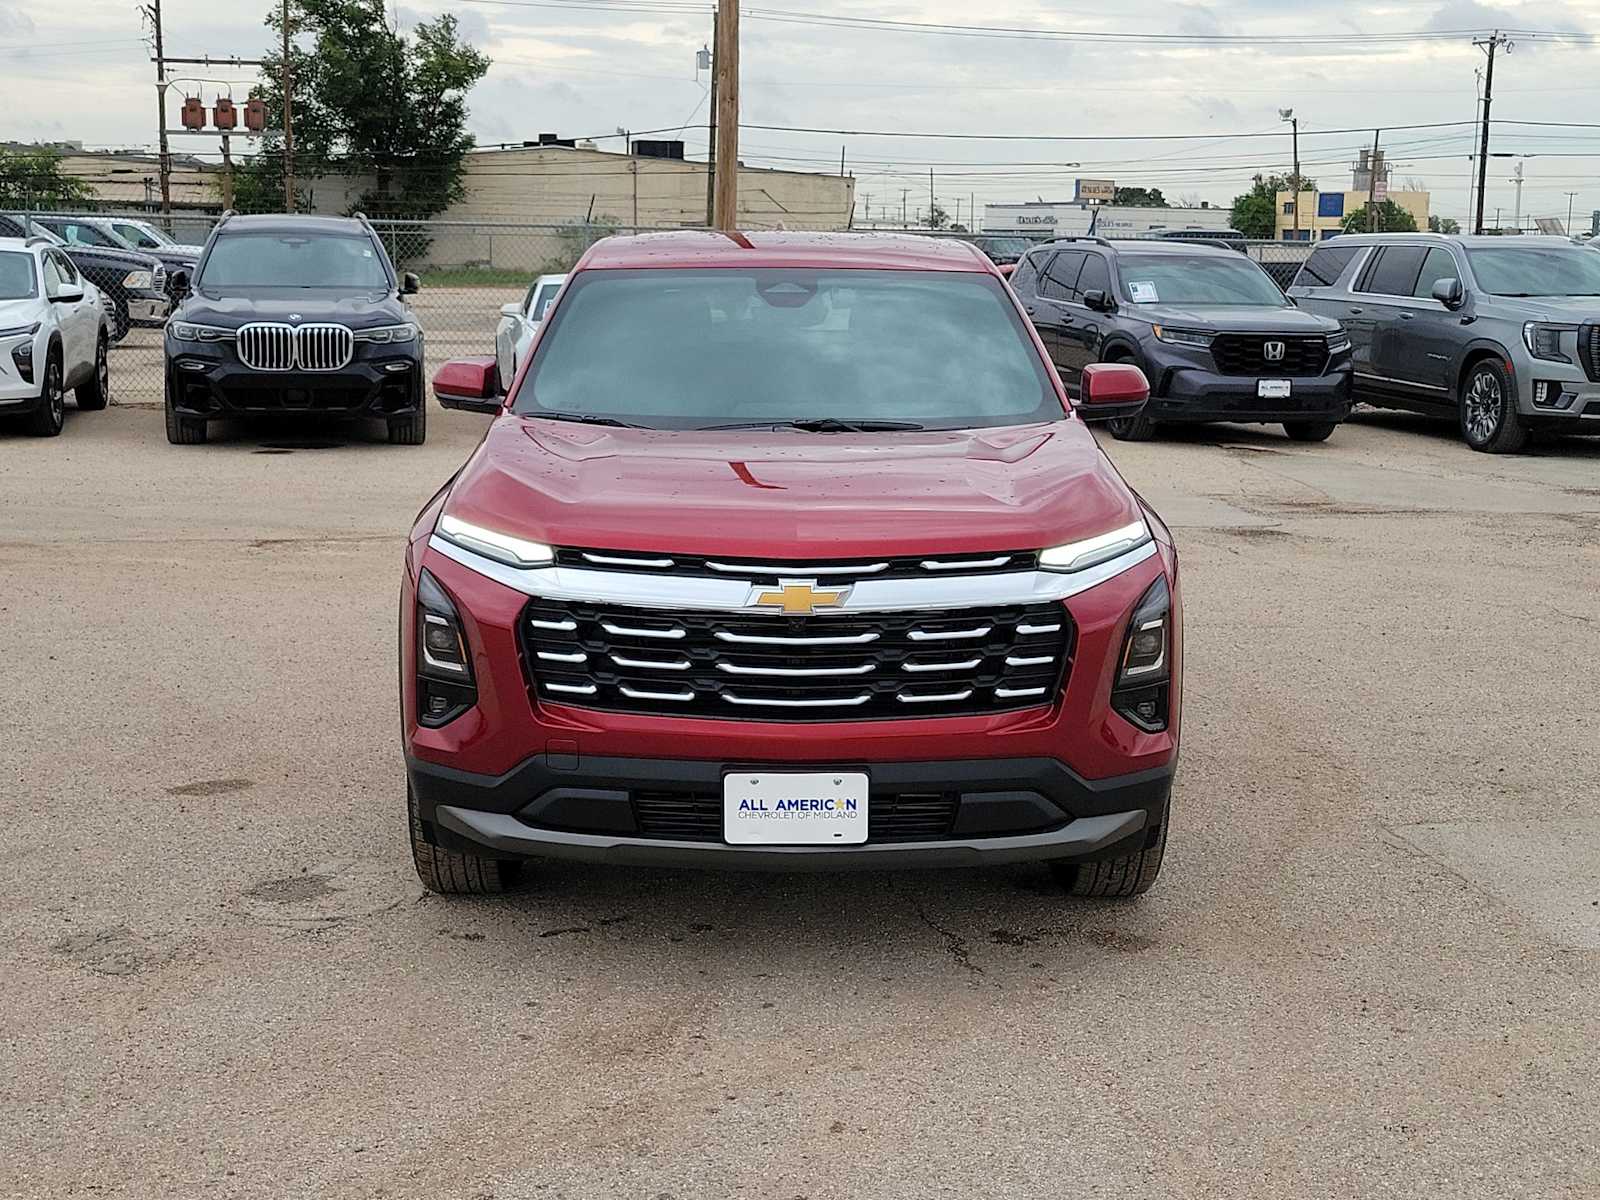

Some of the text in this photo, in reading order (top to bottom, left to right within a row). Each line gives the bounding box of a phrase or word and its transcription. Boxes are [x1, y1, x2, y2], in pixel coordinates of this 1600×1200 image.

[739, 799, 768, 811] ALL
[738, 811, 858, 819] CHEVROLET OF MIDLAND
